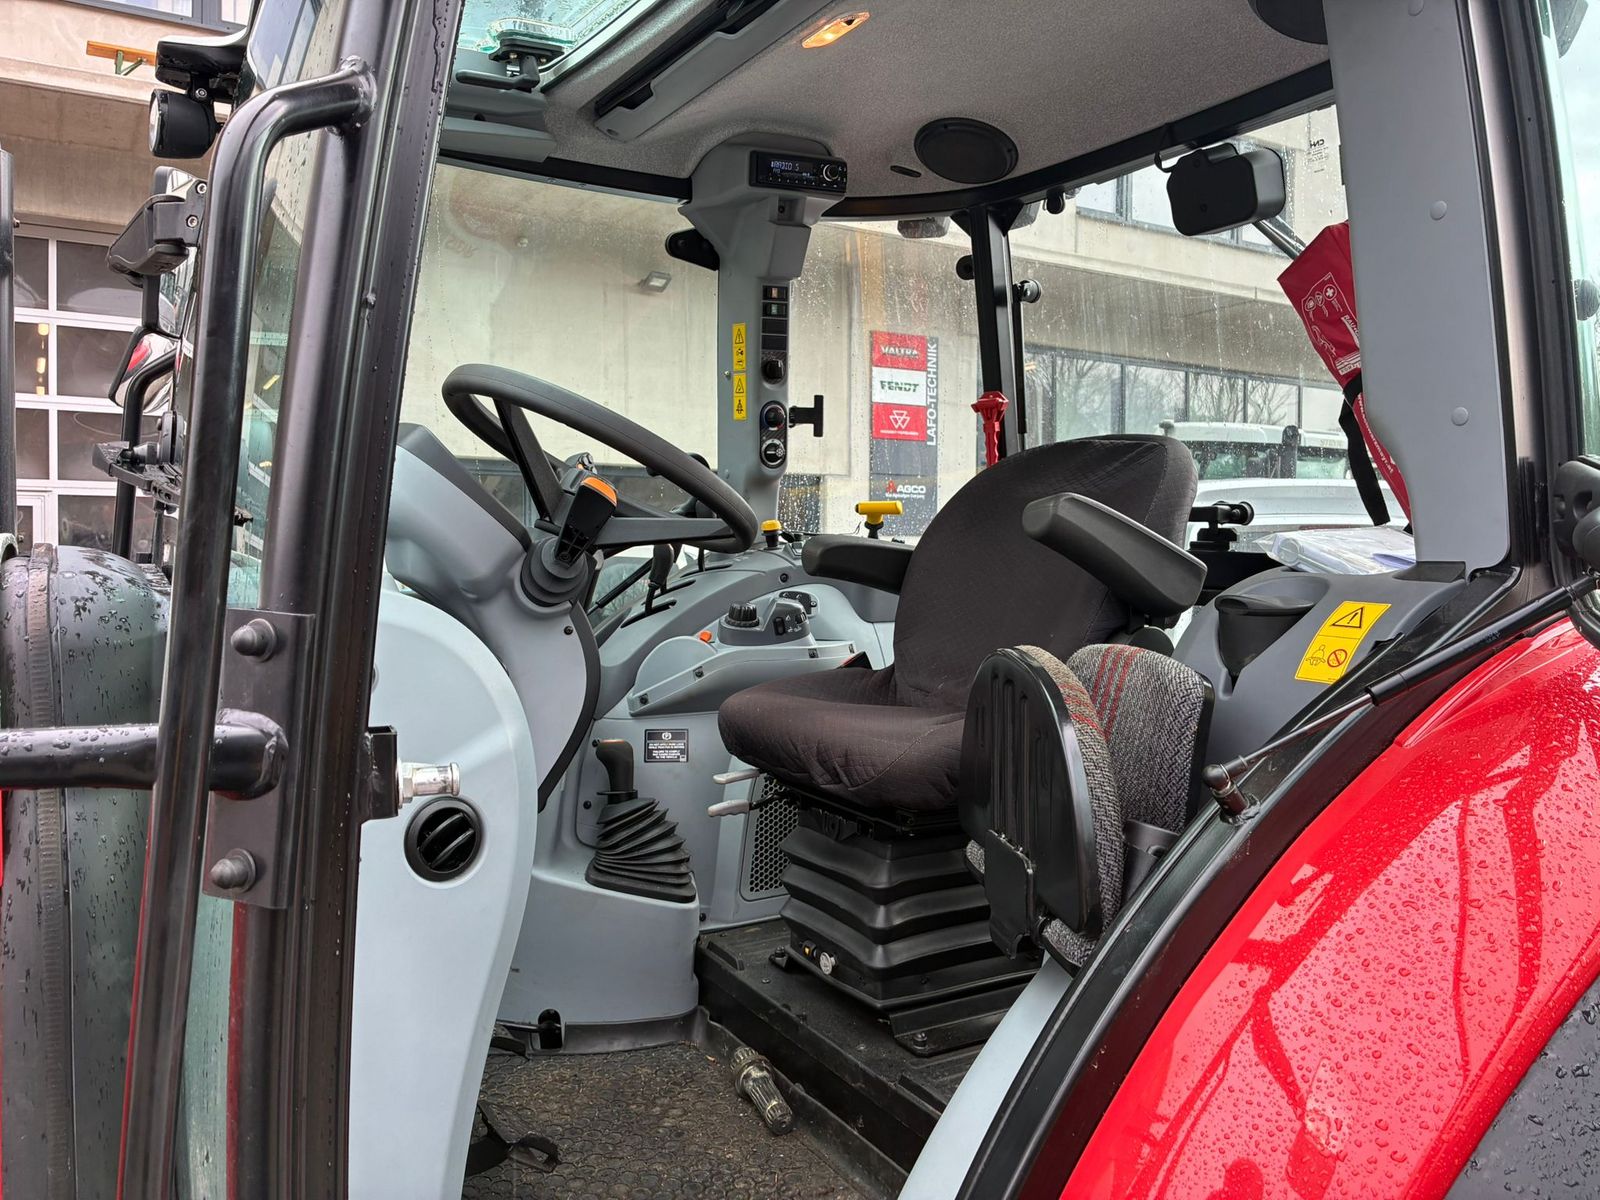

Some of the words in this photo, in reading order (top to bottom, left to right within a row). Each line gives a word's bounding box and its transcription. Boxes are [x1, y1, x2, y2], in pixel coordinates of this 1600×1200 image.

[880, 345, 919, 357] VALTRA
[880, 380, 919, 392] FENDT
[927, 343, 937, 446] LAFO-TECHNIK
[896, 485, 926, 494] AGCO
